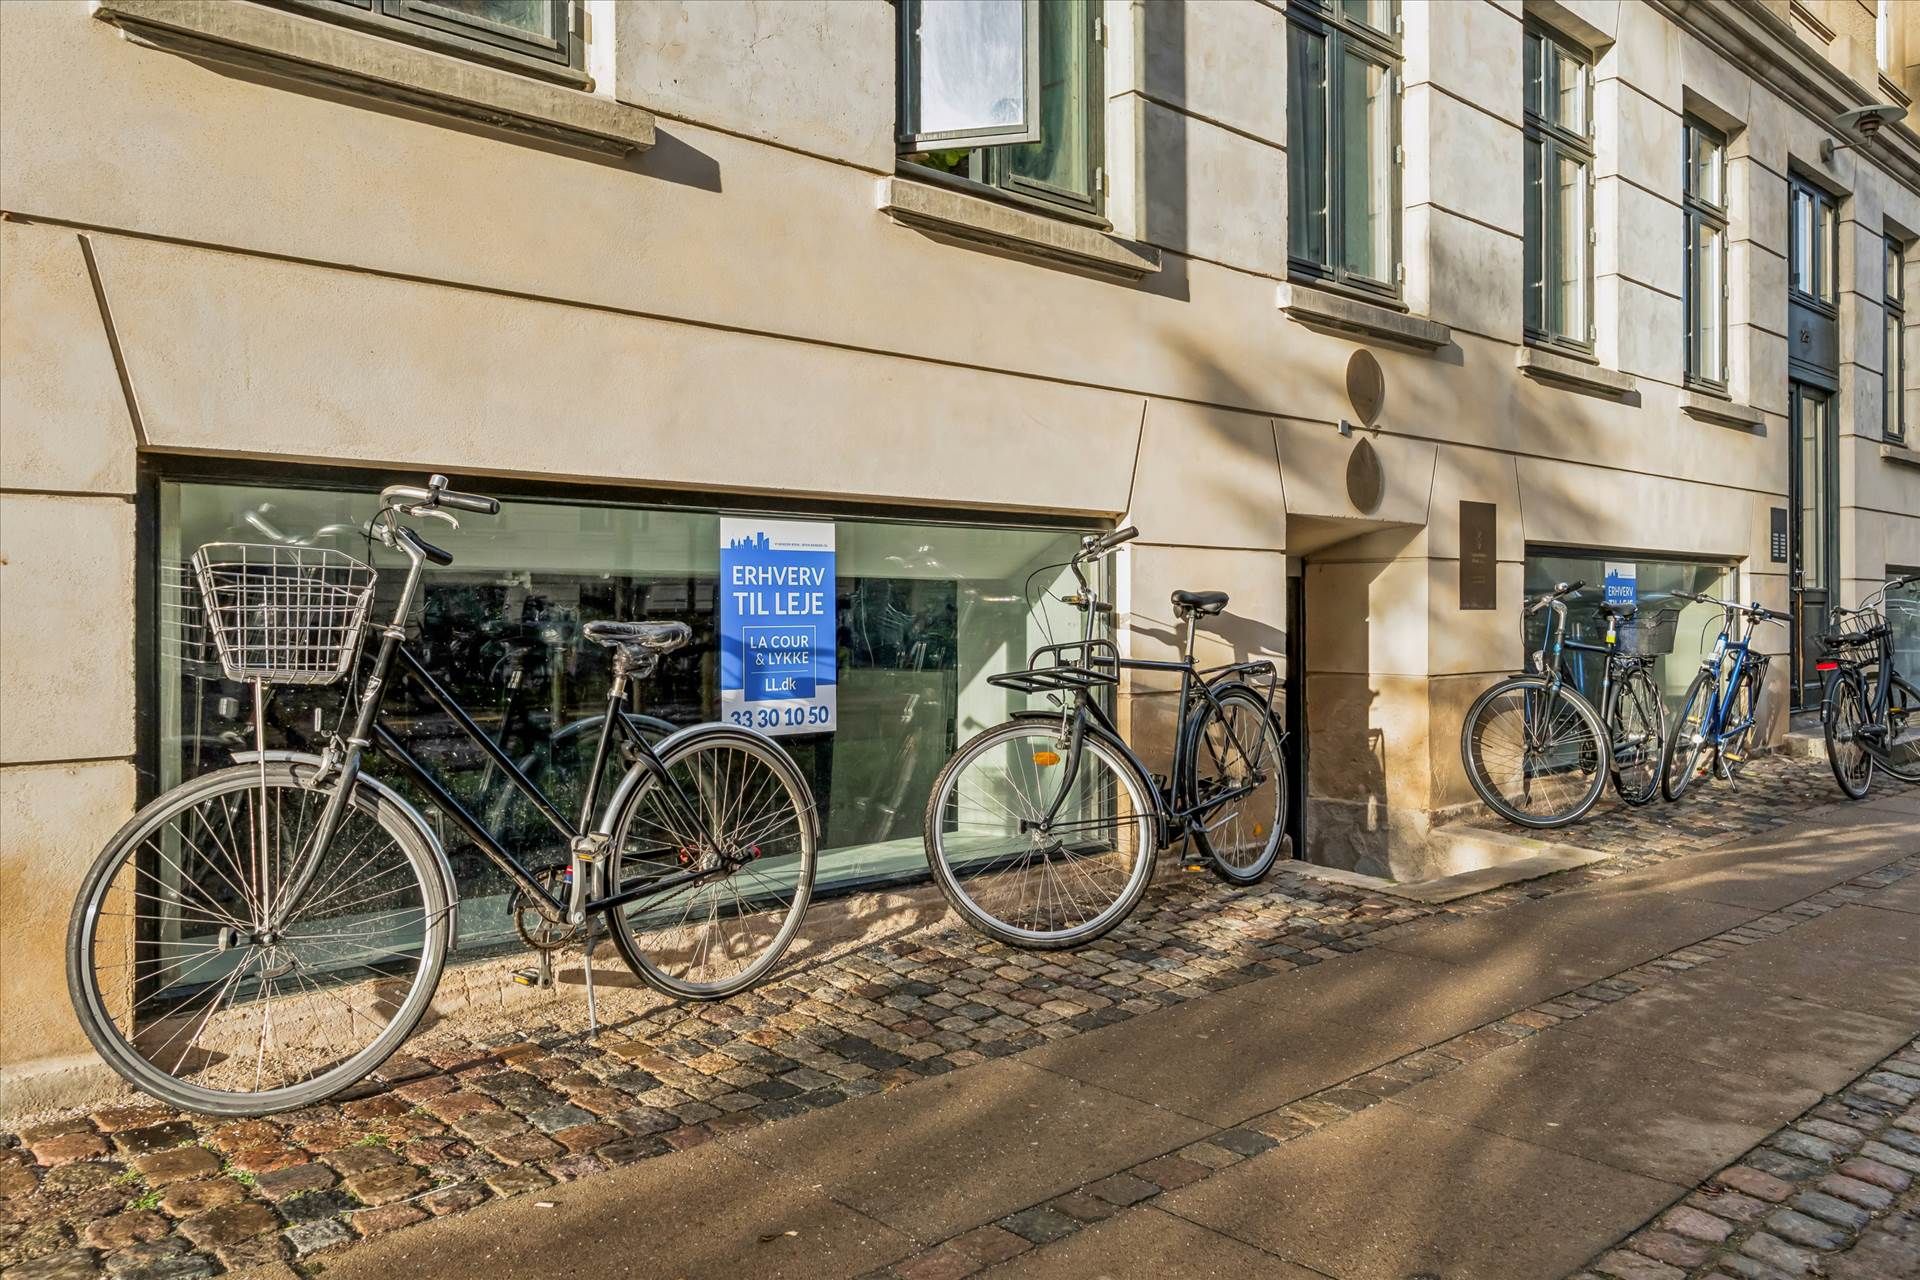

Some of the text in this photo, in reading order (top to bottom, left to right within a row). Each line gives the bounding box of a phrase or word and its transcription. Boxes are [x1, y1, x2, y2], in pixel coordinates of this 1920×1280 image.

[732, 565, 825, 586] ERHVERV
[1608, 586, 1634, 596] ERHVERV
[733, 592, 824, 615] TIL LEJE
[750, 635, 809, 649] LA COUR
[755, 651, 809, 666] & LYKKE
[765, 677, 797, 692] LL.dk
[730, 705, 829, 728] 33 30 10 50
